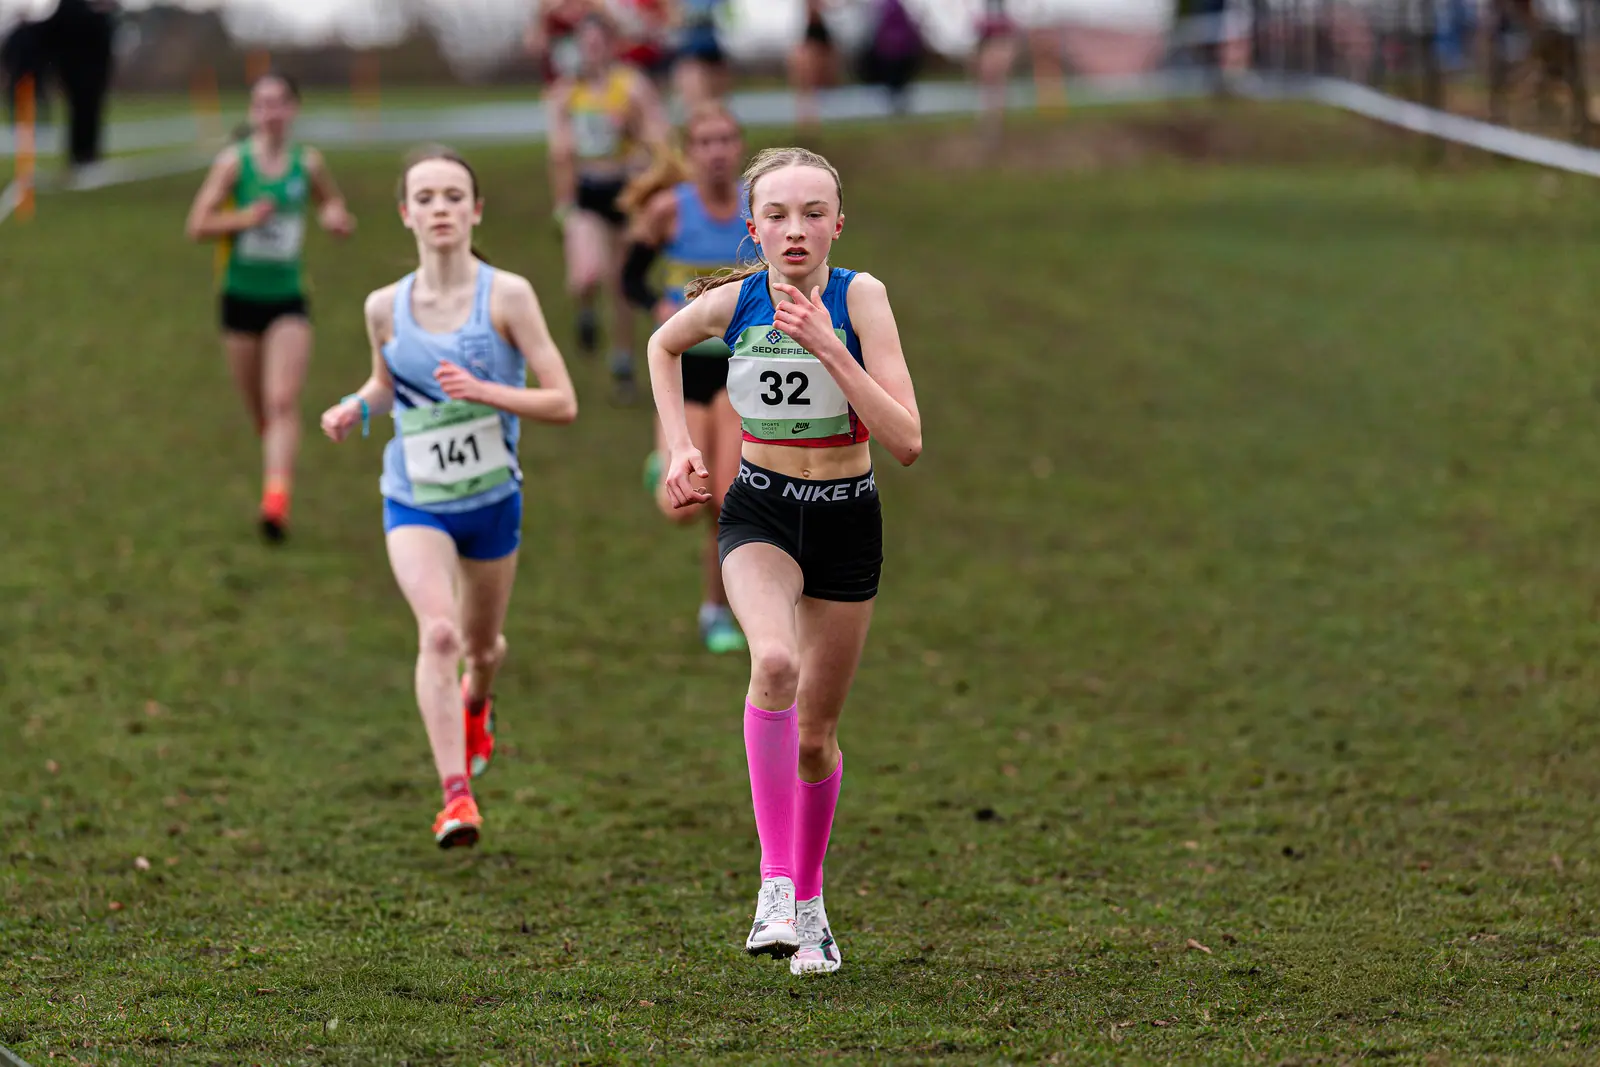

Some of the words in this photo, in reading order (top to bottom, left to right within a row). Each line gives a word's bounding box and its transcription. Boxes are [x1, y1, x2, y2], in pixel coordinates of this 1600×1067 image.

[751, 345, 812, 355] SEDGEFIEL
[759, 370, 811, 406] 32
[430, 433, 480, 471] 141
[782, 481, 851, 502] NIKE
